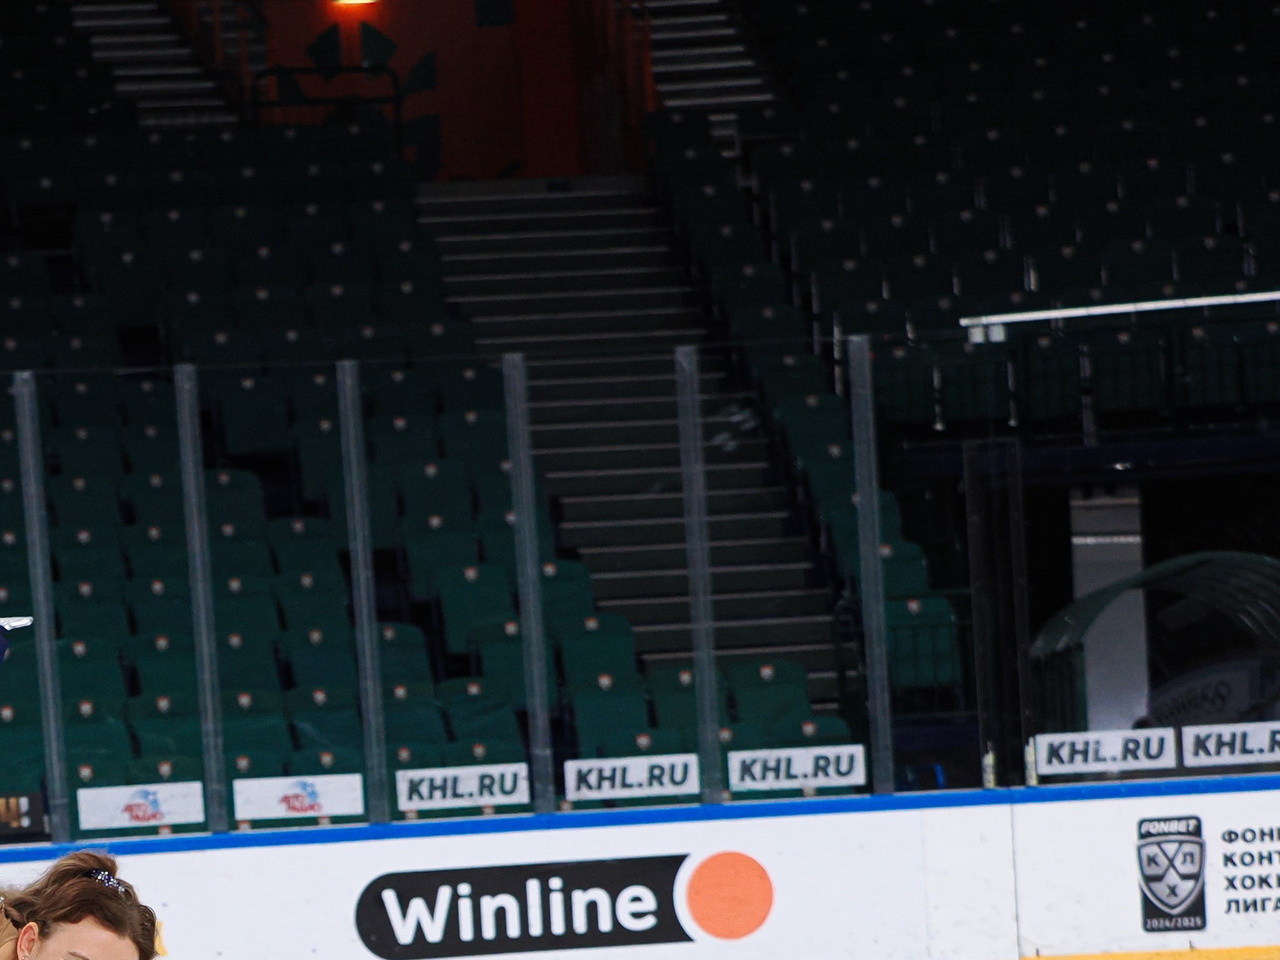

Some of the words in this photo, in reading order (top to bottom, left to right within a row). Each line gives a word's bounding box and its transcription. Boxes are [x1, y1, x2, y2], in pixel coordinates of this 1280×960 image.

[1046, 736, 1165, 766] KHL.RU
[575, 763, 689, 792] KHL.RU
[739, 753, 855, 783] KHL.RU
[407, 772, 519, 802] KHL.RU
[1221, 827, 1280, 845] ФОН
[1224, 873, 1280, 890] ХОК
[381, 876, 659, 945] Winline
